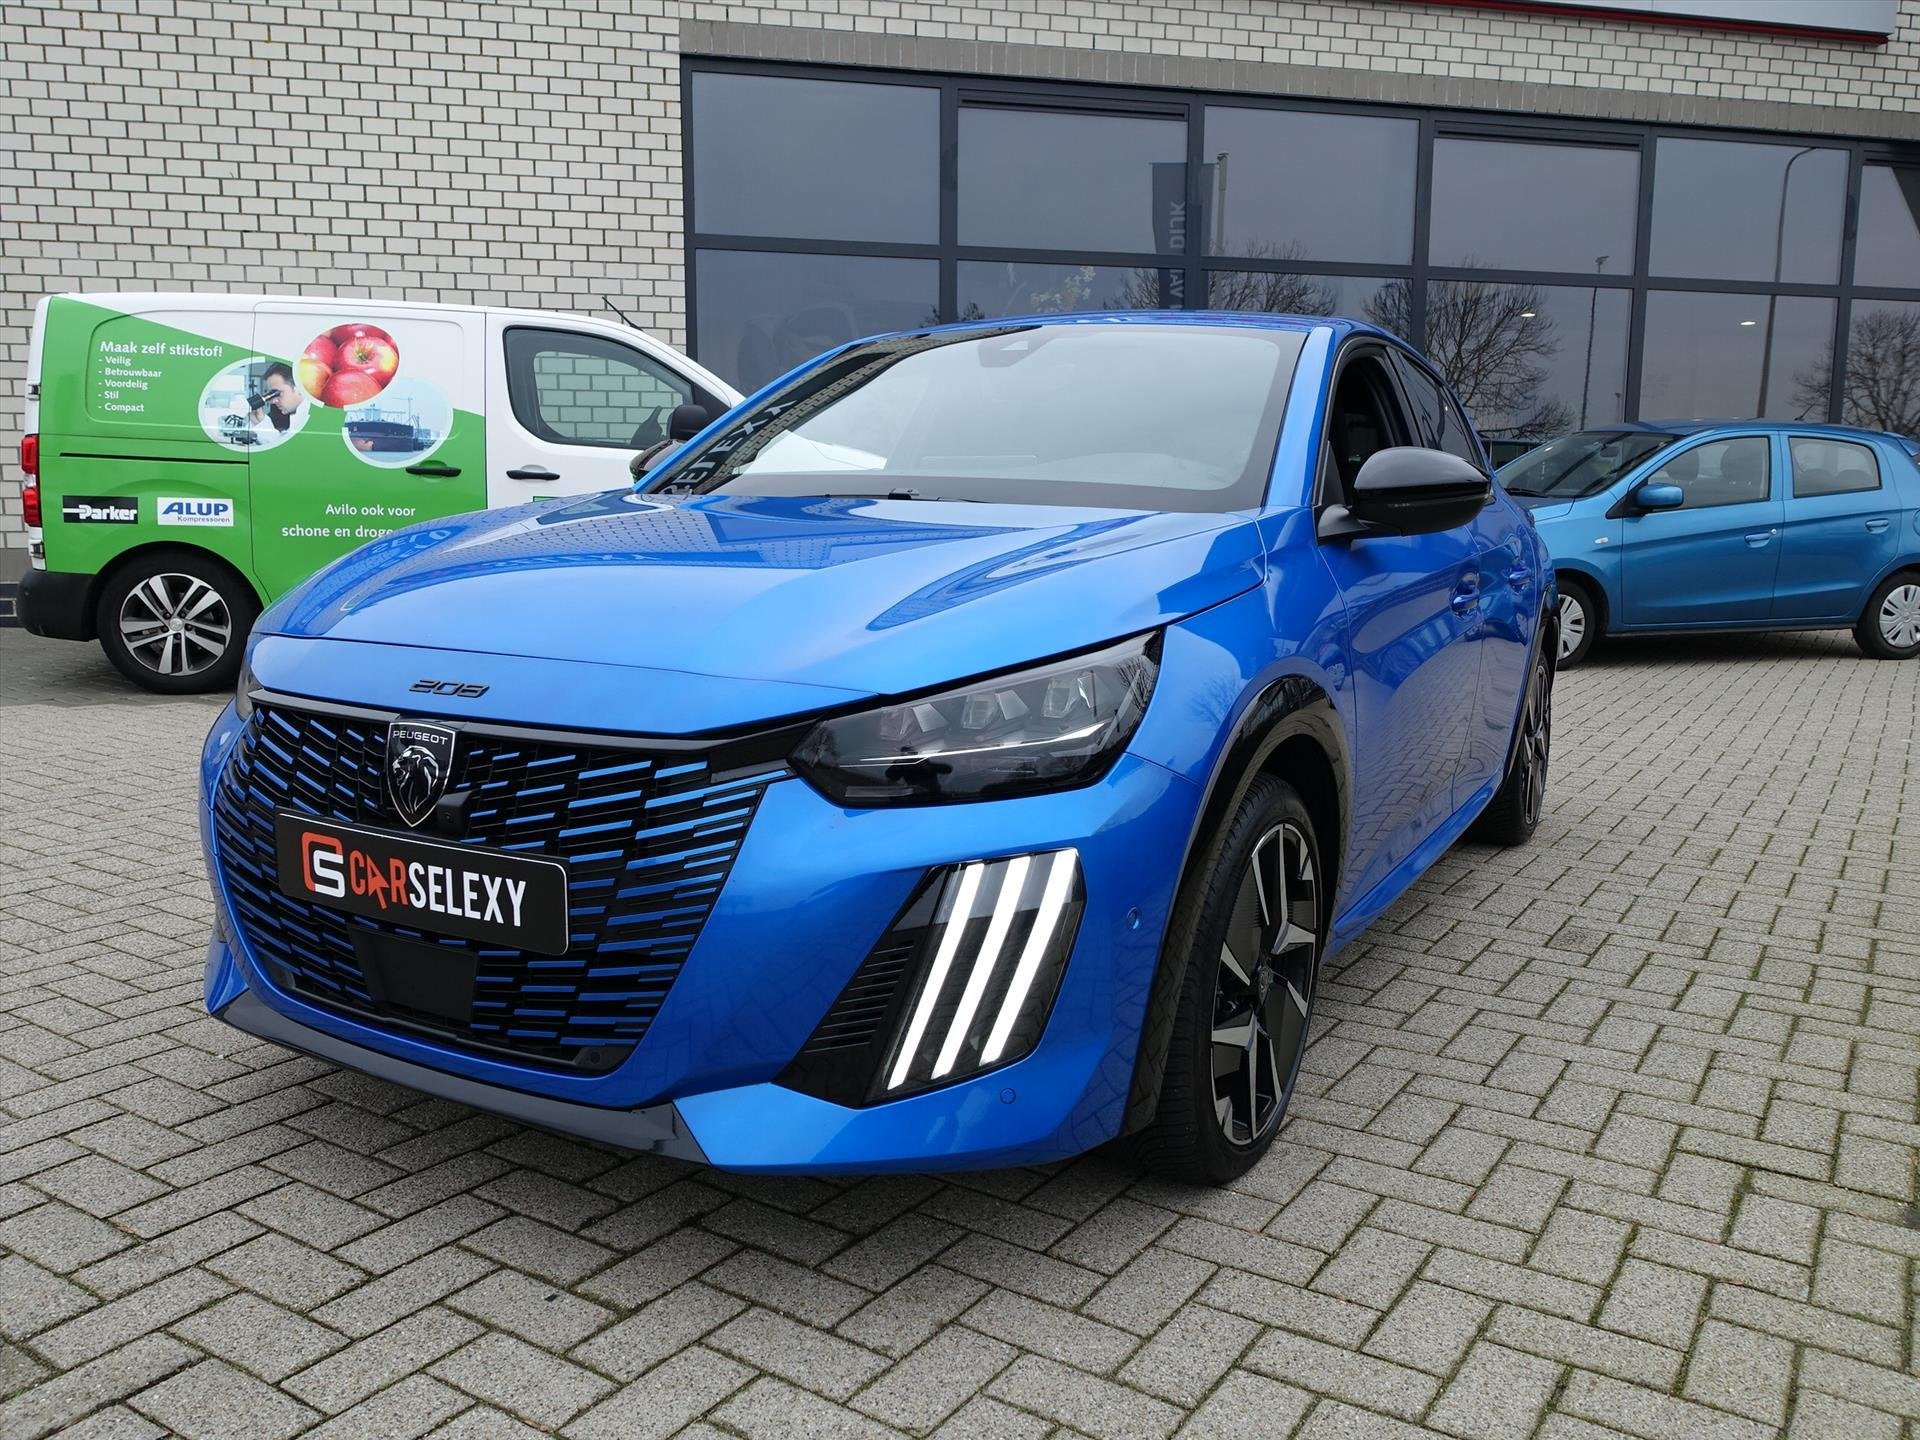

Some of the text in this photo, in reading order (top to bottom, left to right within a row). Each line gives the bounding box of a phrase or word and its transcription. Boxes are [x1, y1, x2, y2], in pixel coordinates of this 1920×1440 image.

[100, 341, 223, 358] Maak zelf stikstof!
[104, 356, 132, 367] Veilig
[104, 368, 162, 378] Betrouwbaar
[104, 379, 149, 390] Voordelig
[104, 391, 119, 399] Stil
[104, 402, 145, 413] Compact
[78, 504, 138, 521] Parker
[161, 502, 229, 516] ALUP
[325, 504, 416, 516] Avilo ook voor
[177, 515, 231, 524] Kompressoren
[281, 524, 330, 537] schone
[334, 528, 351, 538] en
[409, 679, 490, 698] 208
[392, 730, 448, 745] PEUGEOT
[349, 850, 527, 928] CARSELEXY
